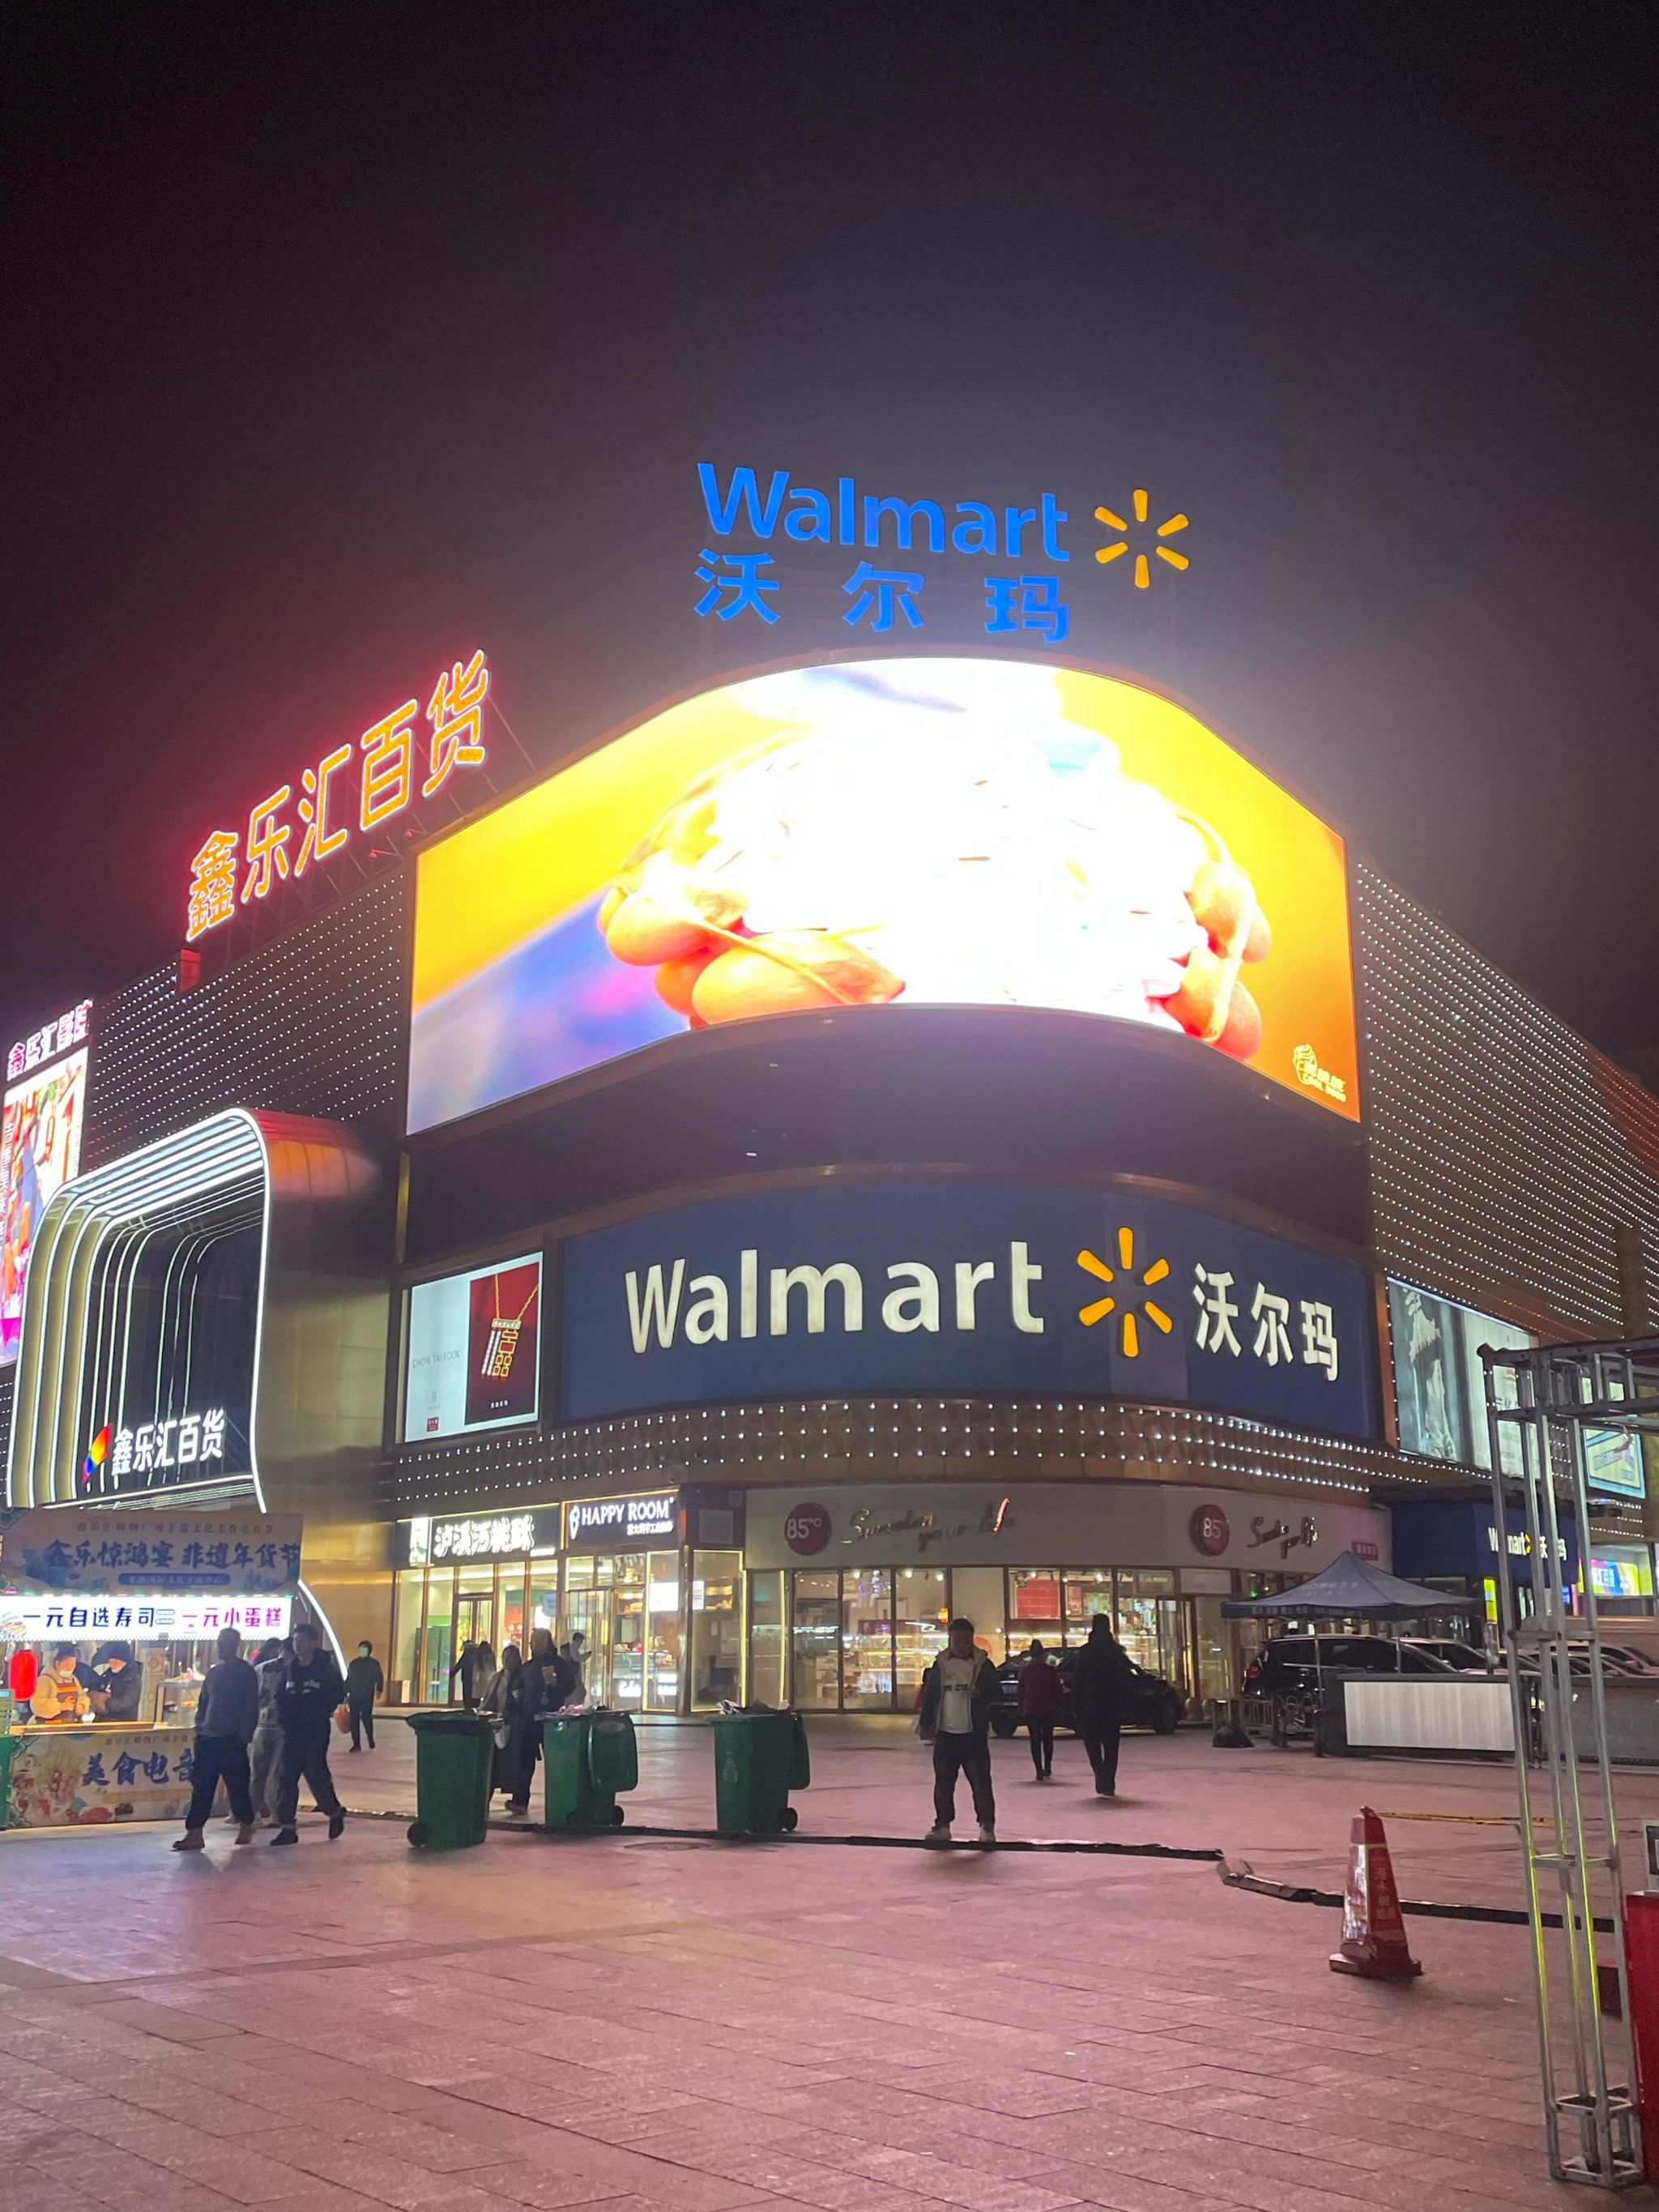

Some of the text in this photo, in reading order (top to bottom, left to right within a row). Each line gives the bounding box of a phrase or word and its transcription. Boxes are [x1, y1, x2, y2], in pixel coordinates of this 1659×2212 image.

[697, 462, 1071, 562] Walmart
[693, 548, 1071, 644] 沃尔玛
[186, 648, 488, 943] 鑫乐汇百货
[625, 1241, 1044, 1355] Walmart
[1192, 1262, 1340, 1382] 沃尔玛
[412, 1349, 460, 1369] CHOW TAI FOOK
[111, 1408, 225, 1476] 鑫乐汇百货
[582, 1499, 669, 1526] HAPPY ROOM
[1488, 1527, 1527, 1556] Wmart
[23, 1607, 282, 1628] 一元自选寿司 一元小蛋糕
